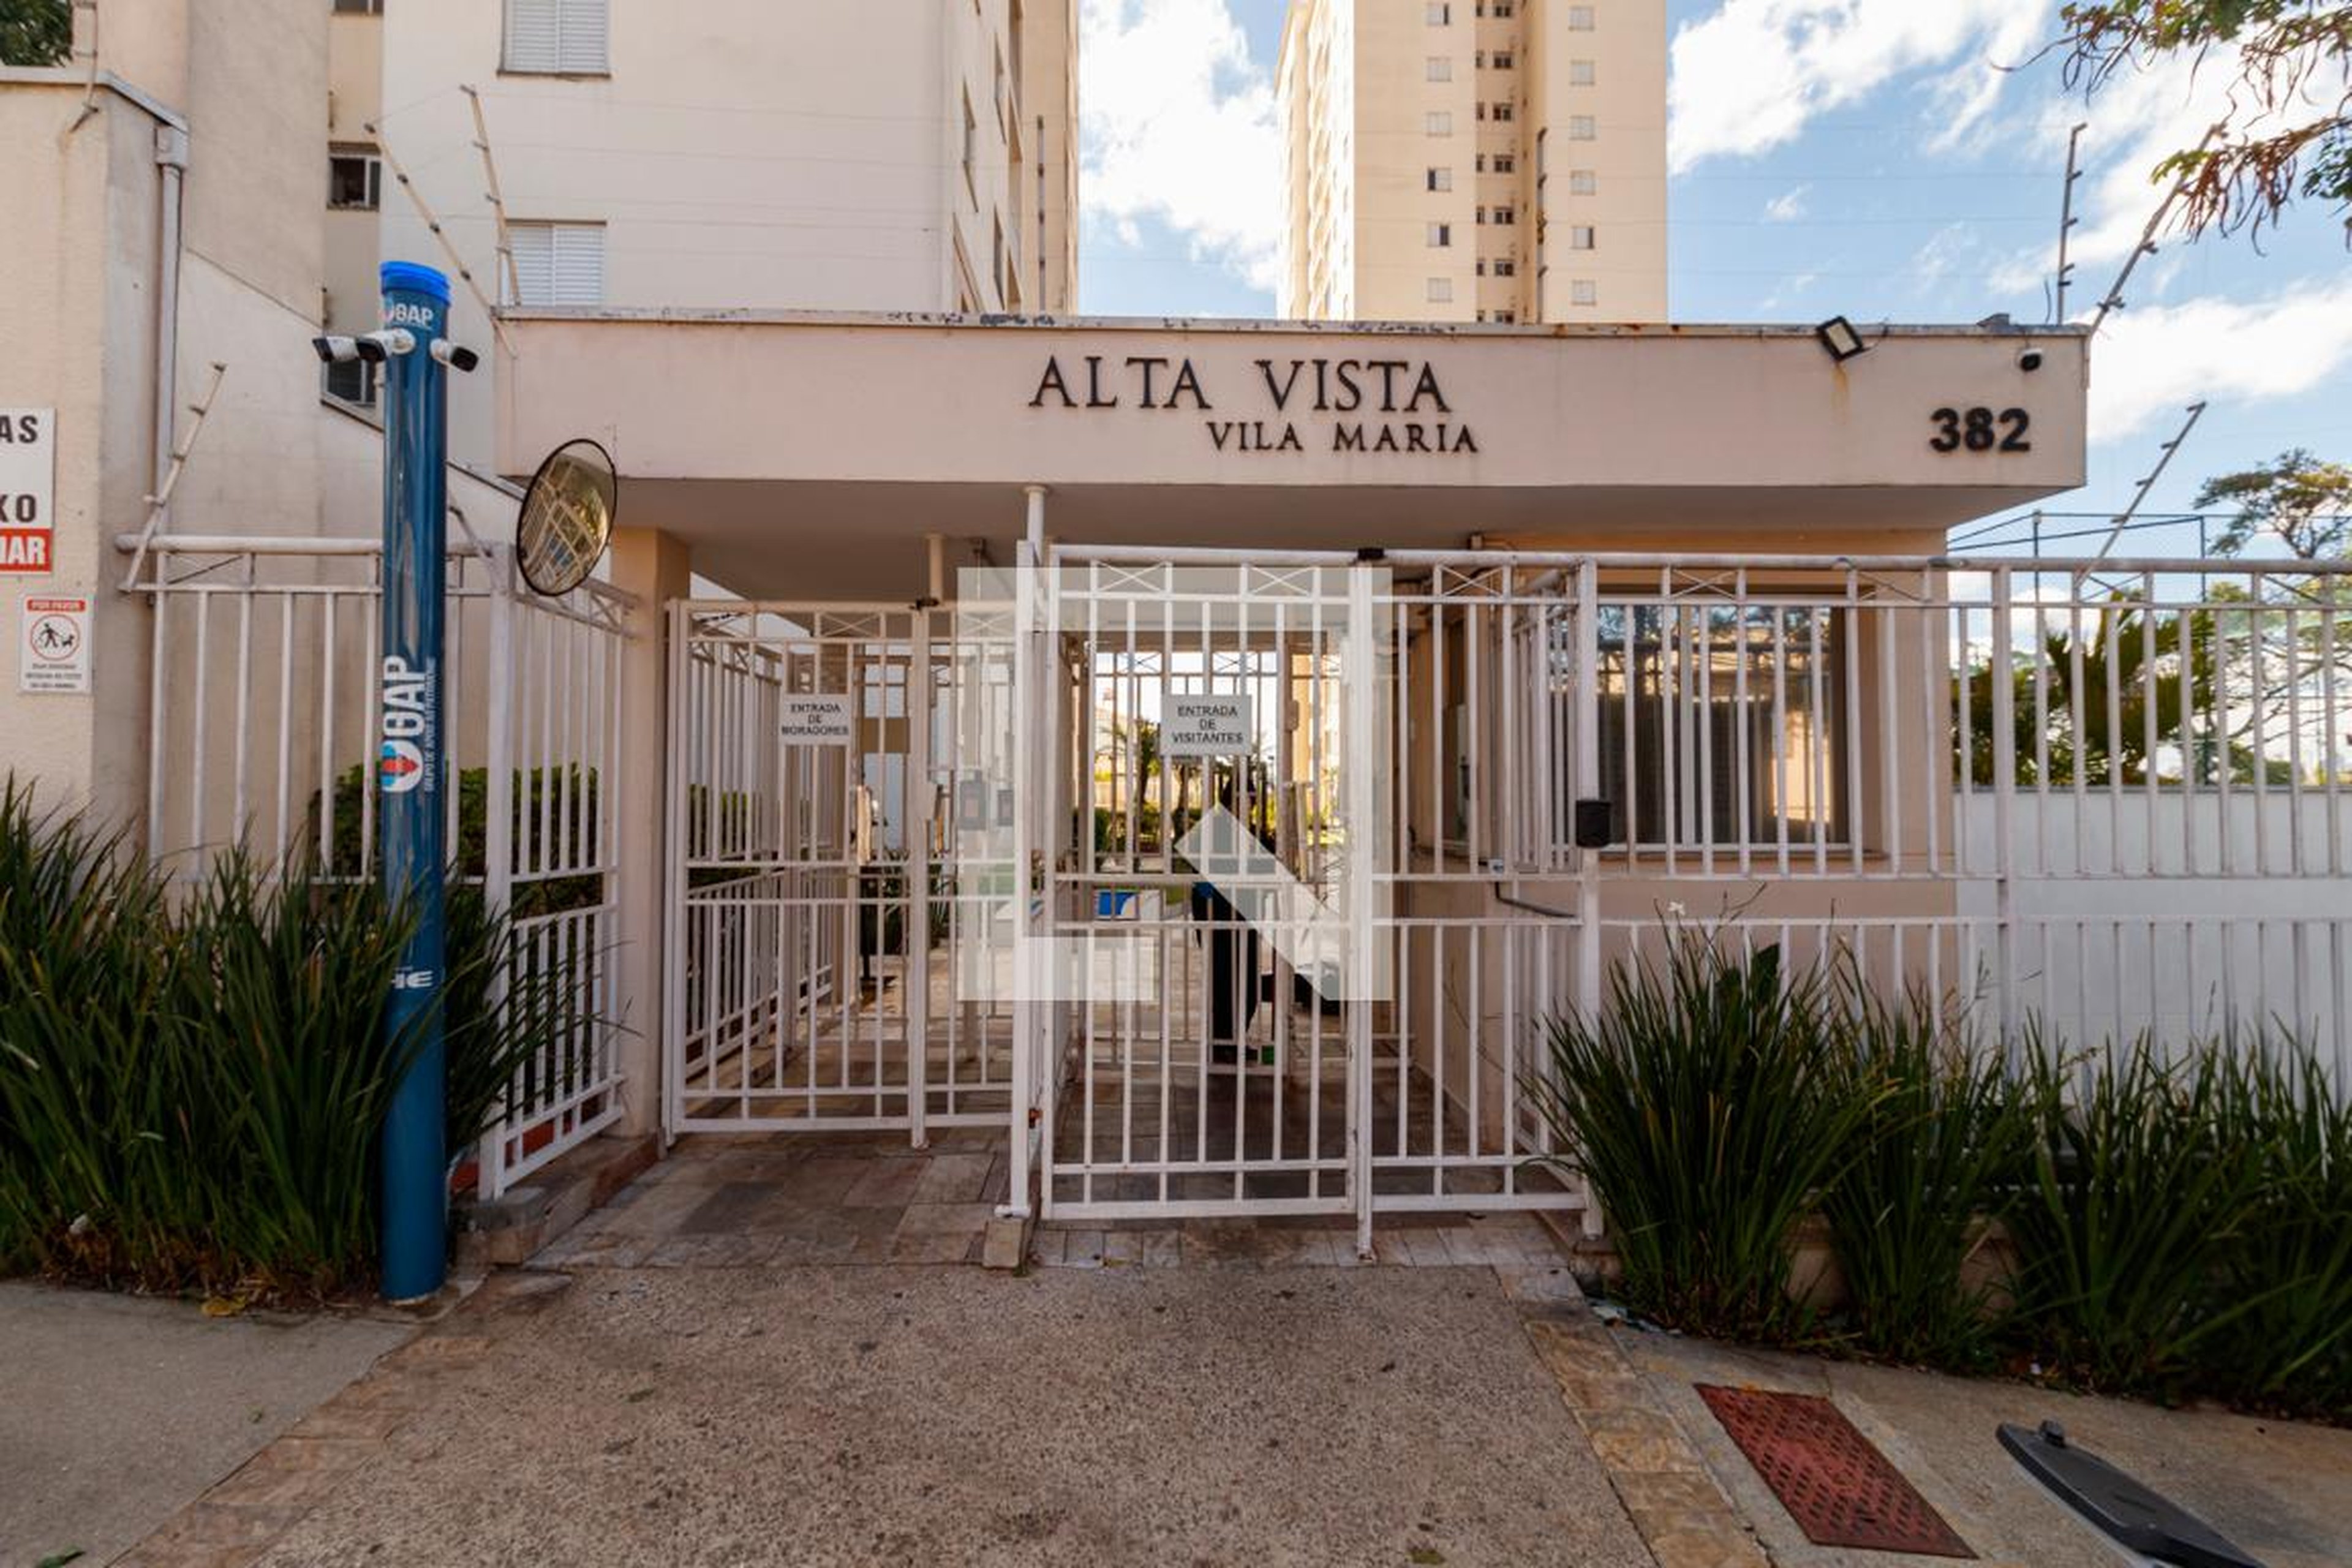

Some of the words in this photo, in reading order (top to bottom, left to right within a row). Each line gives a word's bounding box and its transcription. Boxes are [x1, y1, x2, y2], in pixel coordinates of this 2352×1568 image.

[1029, 356, 1212, 409] ALTA
[1253, 360, 1452, 413] VISTA
[1929, 406, 2031, 454] 382
[1206, 422, 1303, 451] VILA
[1333, 423, 1479, 453] MARIA
[791, 703, 842, 713] ENTRADA
[1177, 704, 1238, 717] ENTRADA
[808, 714, 822, 724] DE
[1199, 718, 1216, 731] DE
[782, 725, 849, 735] MORADORES
[1172, 732, 1244, 744] VISITANTES
